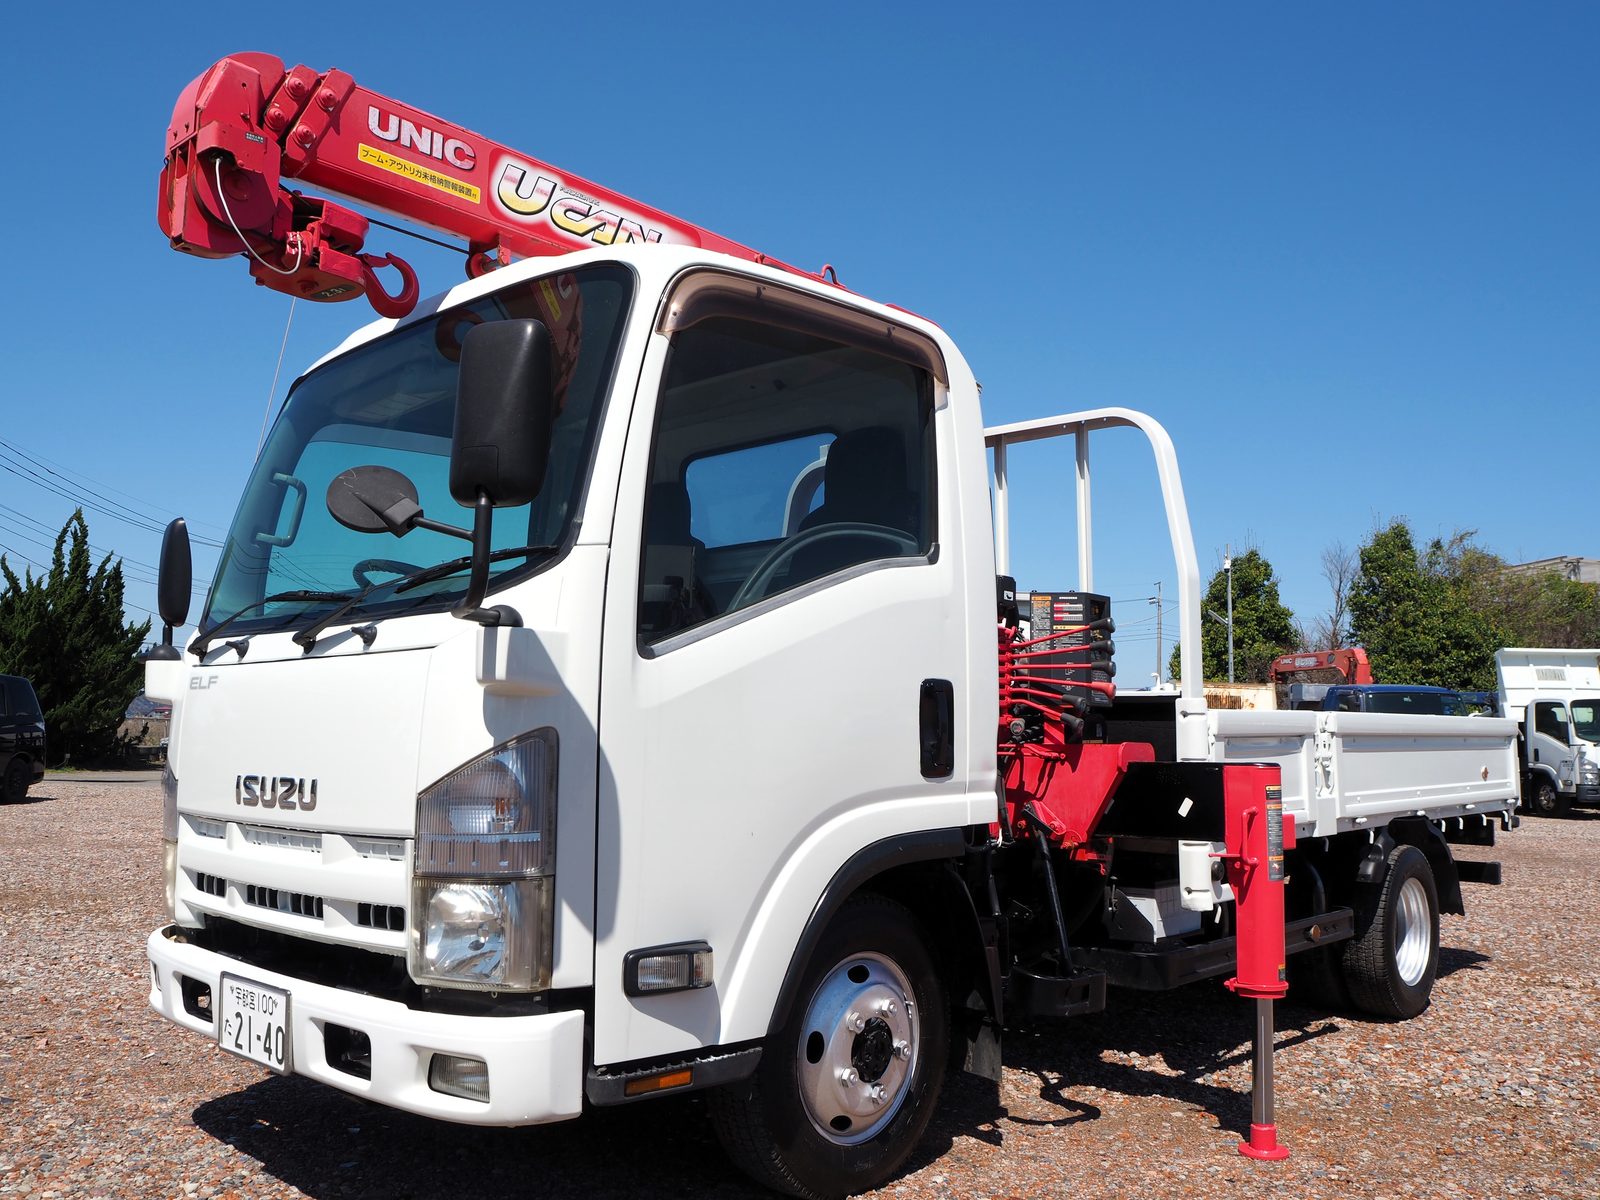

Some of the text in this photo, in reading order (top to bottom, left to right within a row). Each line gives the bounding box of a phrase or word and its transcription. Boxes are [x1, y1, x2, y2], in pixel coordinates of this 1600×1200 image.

[368, 105, 477, 171] UNIC
[497, 163, 663, 246] UCAN
[189, 675, 219, 691] ELF
[235, 774, 318, 811] ISUZU
[234, 1011, 286, 1066] 21-40
